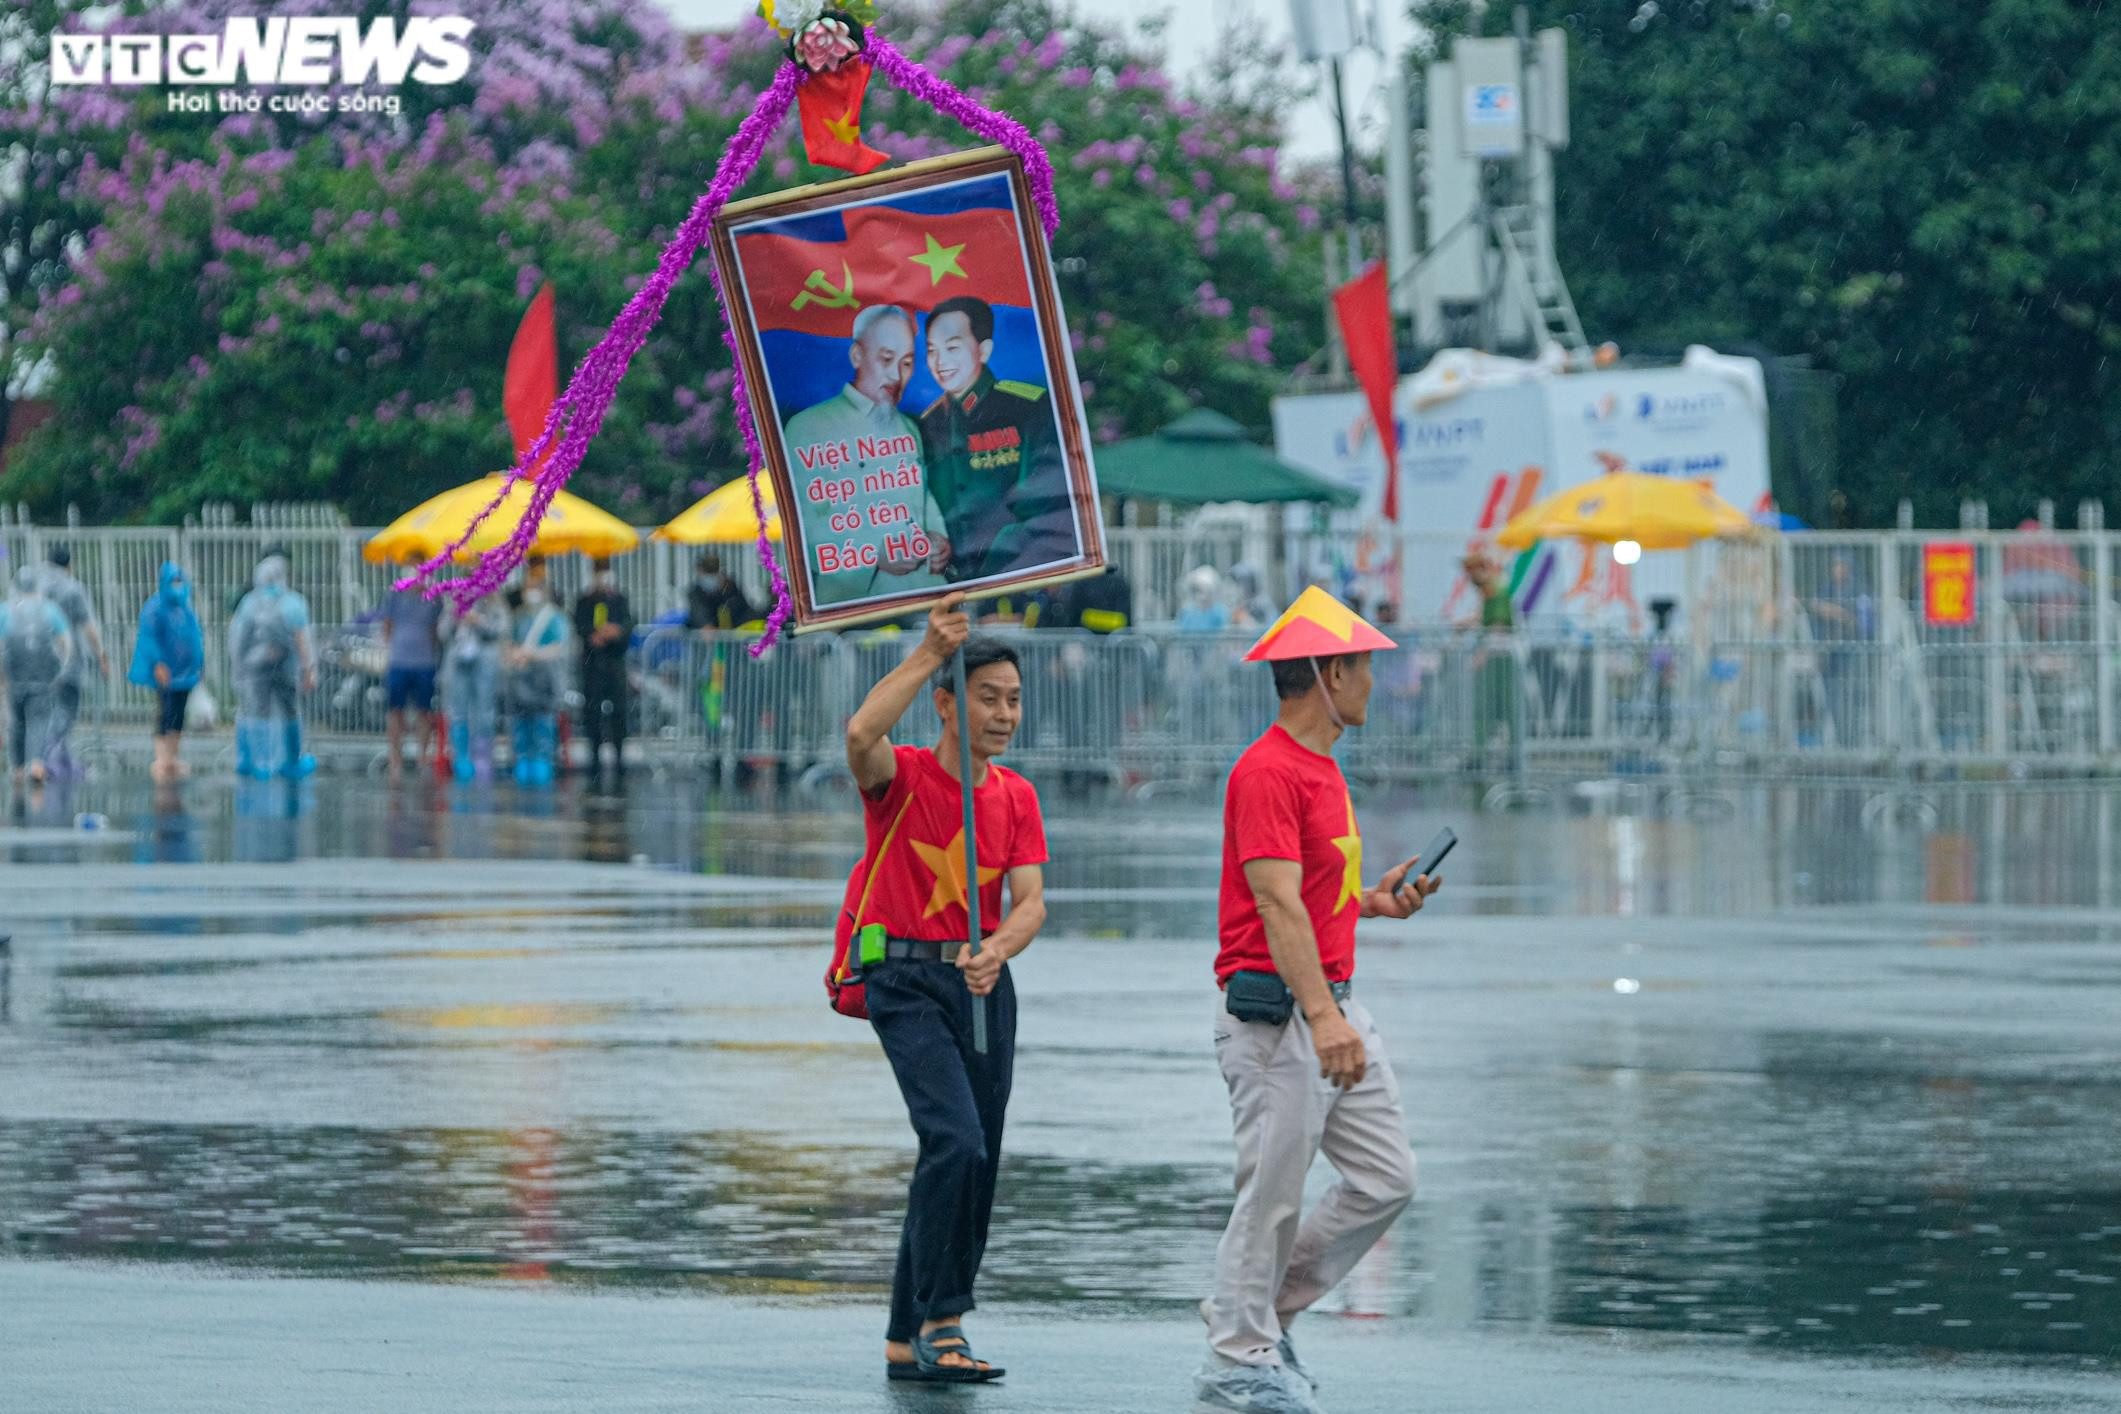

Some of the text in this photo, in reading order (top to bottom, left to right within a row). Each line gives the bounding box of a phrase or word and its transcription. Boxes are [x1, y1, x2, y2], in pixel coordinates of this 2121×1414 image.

[795, 434, 917, 470] Việt Nam
[807, 459, 921, 505] đẹp nhất
[830, 501, 909, 533] có tên
[816, 523, 931, 574] Bác Hồ
